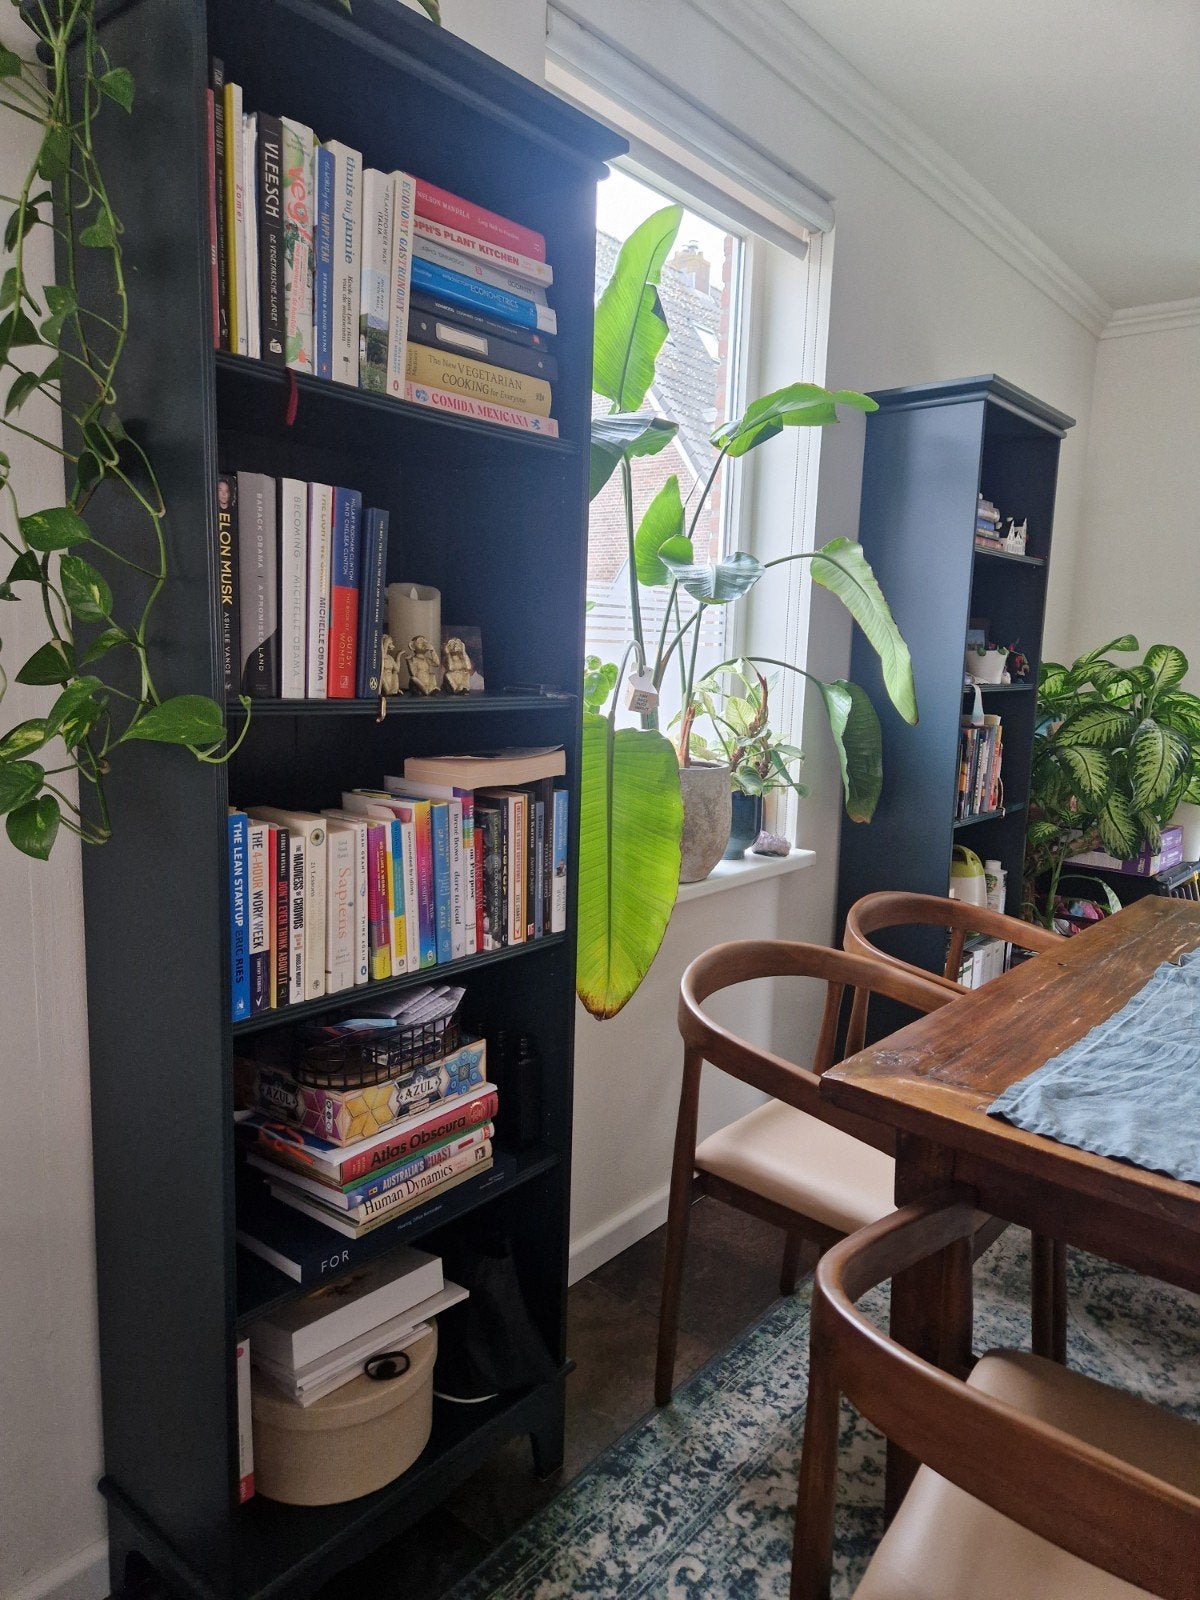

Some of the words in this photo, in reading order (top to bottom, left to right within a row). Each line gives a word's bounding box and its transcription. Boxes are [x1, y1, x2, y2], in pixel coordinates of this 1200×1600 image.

[264, 142, 280, 219] VLEESCH
[345, 156, 356, 198] thuis
[399, 181, 411, 237] ECONOMY
[442, 198, 471, 220] MANDELA
[321, 211, 330, 240] HAPPY
[342, 213, 356, 264] jamie
[321, 241, 330, 263] PEAR
[444, 229, 477, 250] PLANT
[478, 244, 520, 266] KITCHEN
[396, 238, 408, 312] GASTRONOMY
[441, 372, 489, 395] COOKING
[457, 362, 522, 391] VEGETARIAN
[431, 393, 475, 415] COMIDA
[477, 404, 529, 428] MEXICANA
[256, 493, 264, 531] BARACK
[293, 496, 301, 559] BECOMING
[219, 512, 231, 557] ELON
[256, 535, 264, 569] OBAMA
[220, 560, 233, 605] MUSK
[293, 574, 301, 630] MICHELLE
[318, 597, 326, 644] MICHELLE
[292, 636, 301, 678] OBAMA
[317, 646, 325, 681] OBAMA
[338, 632, 346, 669] WOMEN
[233, 821, 243, 843] THE
[252, 831, 263, 849] THE
[453, 813, 461, 836] Brené
[233, 847, 243, 876] LEAN
[252, 851, 264, 889] 4-HOUR
[293, 853, 304, 891] MADNESS
[278, 881, 288, 903] DON'T
[453, 871, 461, 893] dare
[234, 879, 244, 927] STARTUP
[252, 890, 264, 920] WORK
[278, 905, 288, 925] EVEN
[293, 897, 304, 930] CROWDS
[335, 867, 352, 939] Sapiens
[454, 894, 461, 904] to
[454, 905, 462, 925] lead
[235, 930, 244, 957] ERIC
[252, 921, 264, 949] WEEK
[278, 927, 288, 950] THINK
[235, 958, 244, 984] RIES
[278, 952, 288, 976] ABOUT
[278, 977, 288, 985] IT
[404, 1080, 434, 1101] AZUL
[370, 1142, 408, 1168] Atlas
[408, 1116, 467, 1149] Obscura
[363, 1189, 404, 1216] Human
[405, 1163, 454, 1196] Dynamics
[382, 1160, 425, 1191] AUSTRALIA'S
[320, 1250, 350, 1275] FOR
